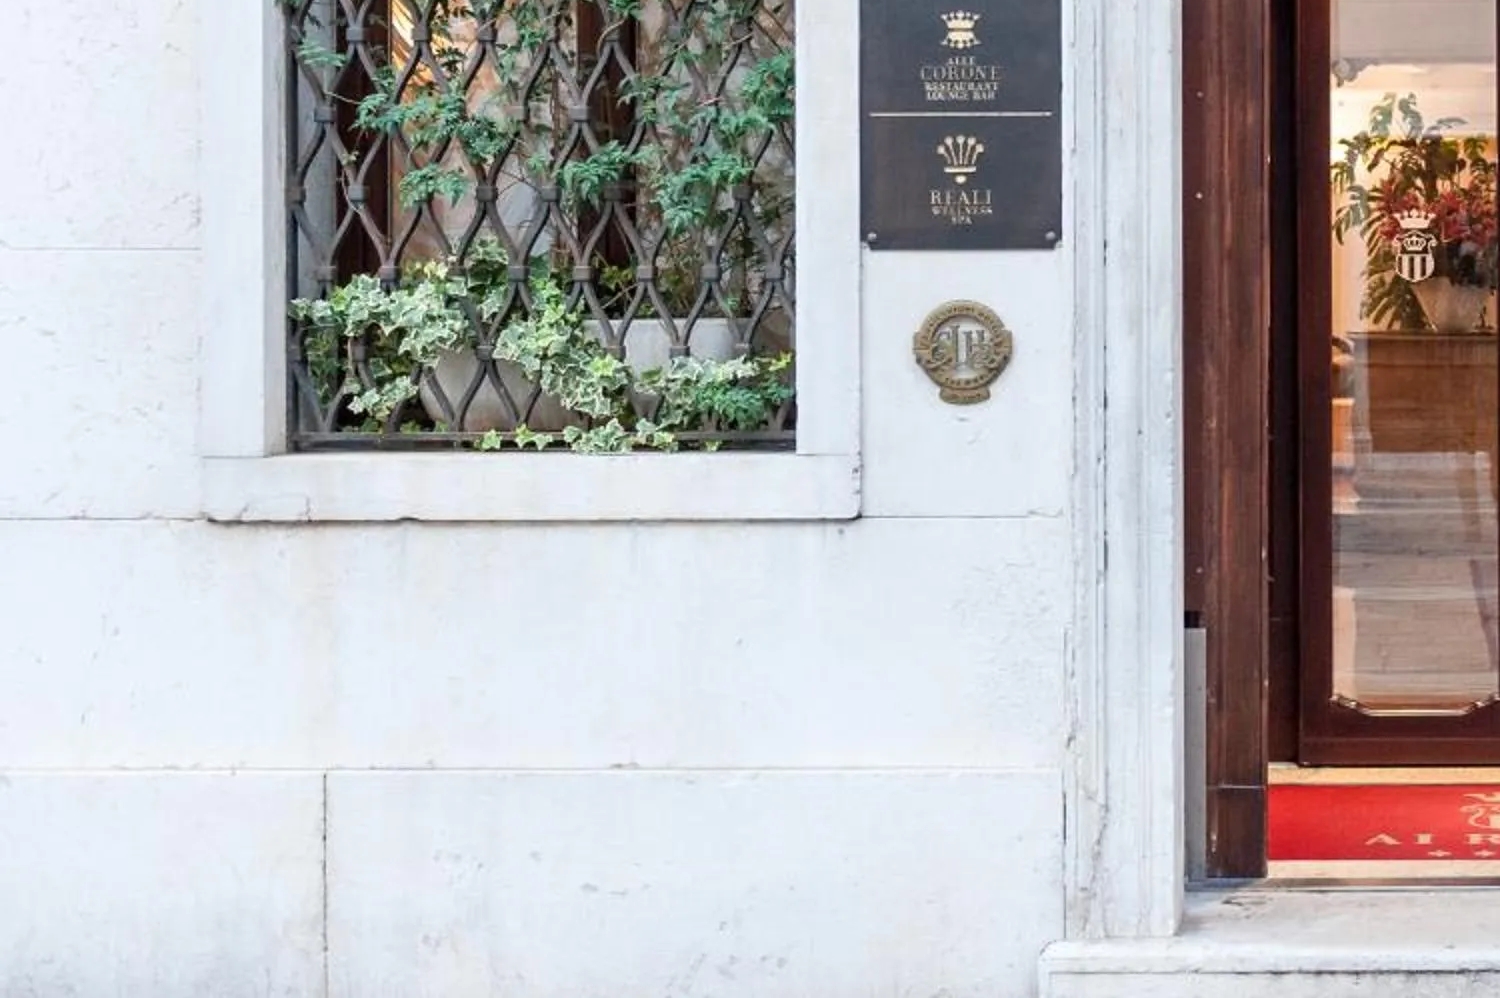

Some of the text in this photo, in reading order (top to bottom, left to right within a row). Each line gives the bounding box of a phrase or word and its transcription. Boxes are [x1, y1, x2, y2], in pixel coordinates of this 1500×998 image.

[920, 65, 1002, 80] CORONE
[924, 81, 999, 91] RESTAURANT
[929, 189, 993, 205] REALI
[1364, 832, 1432, 845] AI
